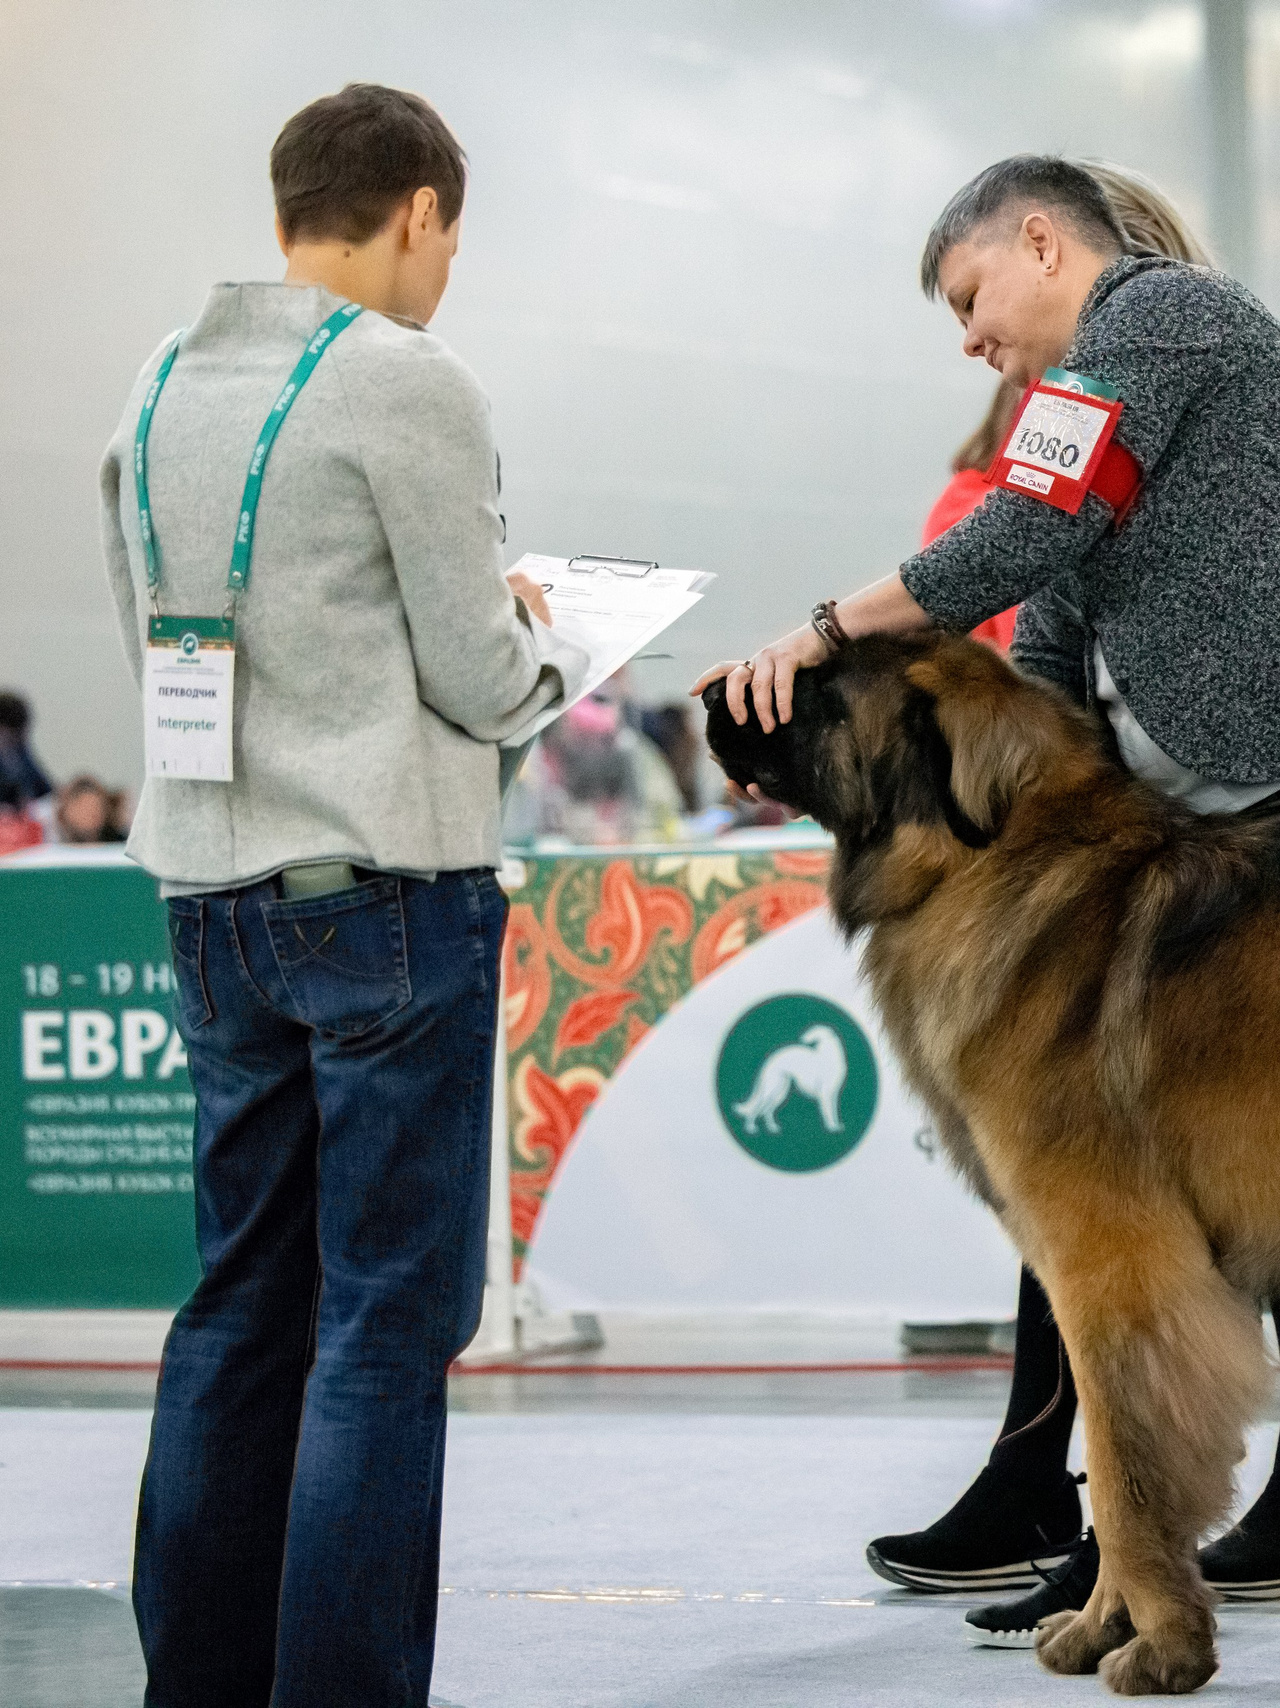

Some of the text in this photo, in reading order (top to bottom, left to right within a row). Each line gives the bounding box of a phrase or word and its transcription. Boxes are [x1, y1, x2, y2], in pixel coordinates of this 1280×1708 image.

[1016, 428, 1079, 468] 1080
[1010, 473, 1048, 491] ROYAL CANIN
[158, 686, 217, 699] ПЕРЕВОДЧИК
[158, 715, 216, 733] Interpreter
[23, 962, 60, 997] 18
[98, 962, 135, 996] 19
